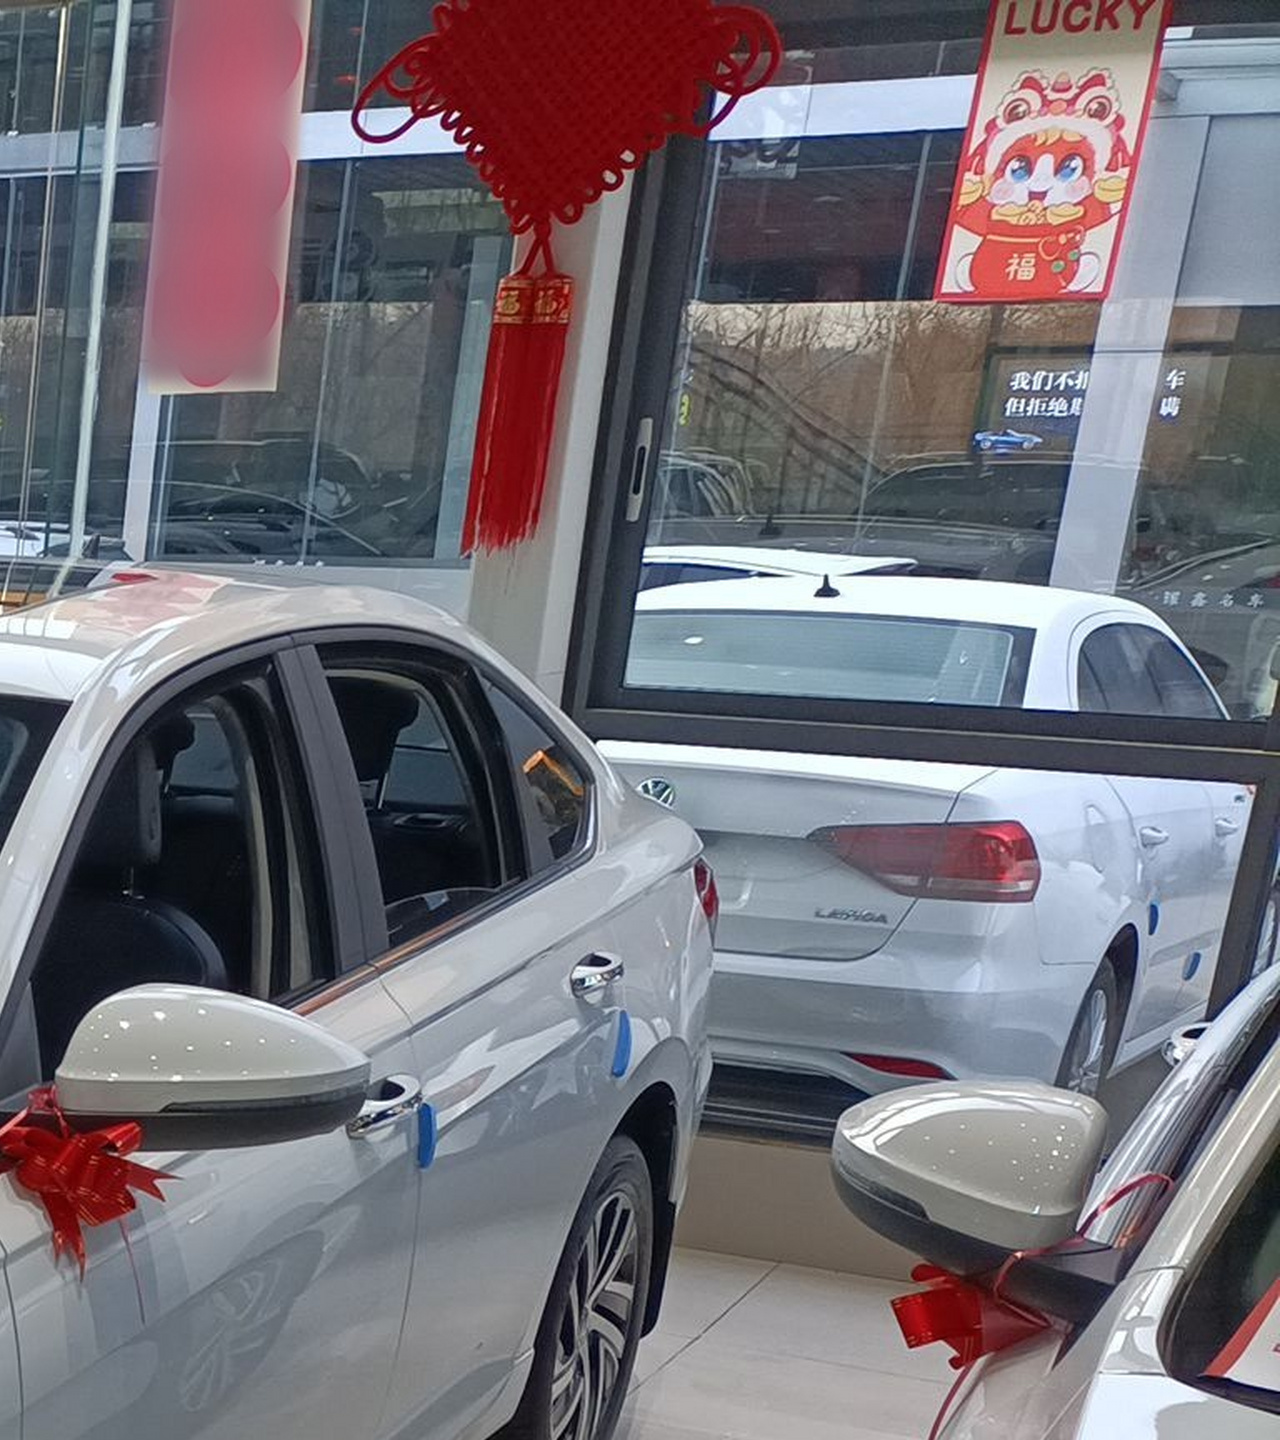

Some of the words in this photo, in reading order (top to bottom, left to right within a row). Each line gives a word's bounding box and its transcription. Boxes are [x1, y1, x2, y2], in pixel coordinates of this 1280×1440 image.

[1003, 0, 1154, 35] LUCKY
[1005, 253, 1037, 281] 福
[1165, 369, 1187, 391] 车
